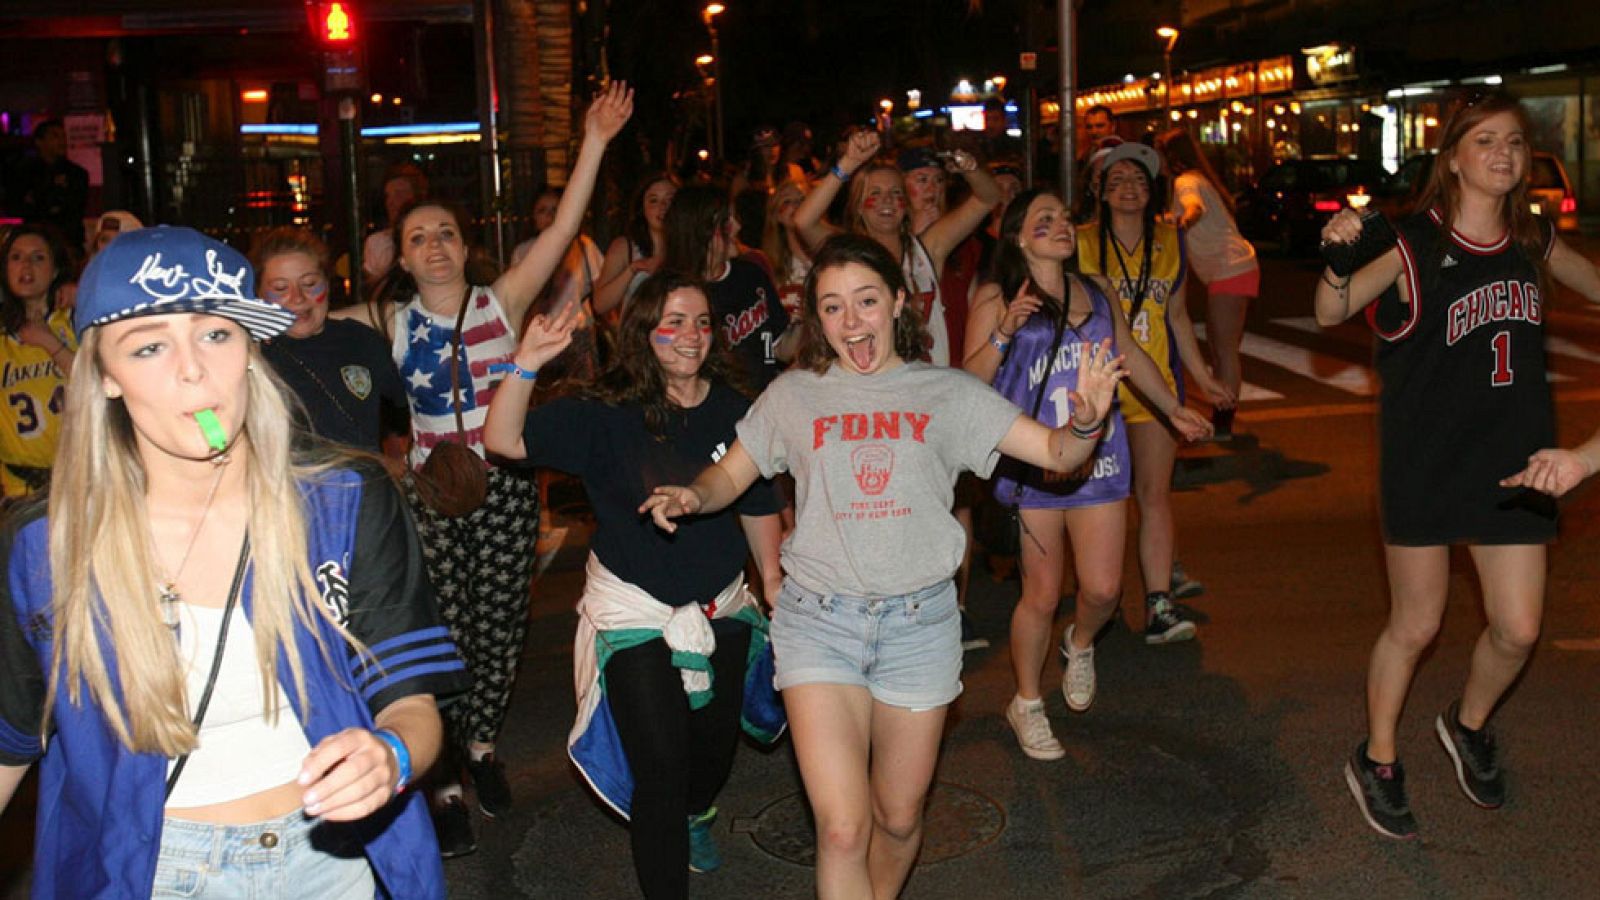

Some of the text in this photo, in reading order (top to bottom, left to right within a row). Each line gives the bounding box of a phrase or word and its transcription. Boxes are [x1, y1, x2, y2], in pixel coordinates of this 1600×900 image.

[1446, 280, 1541, 346] CHICAG
[2, 361, 64, 388] LAKER
[1491, 331, 1513, 387] 1
[813, 411, 931, 450] FDNY
